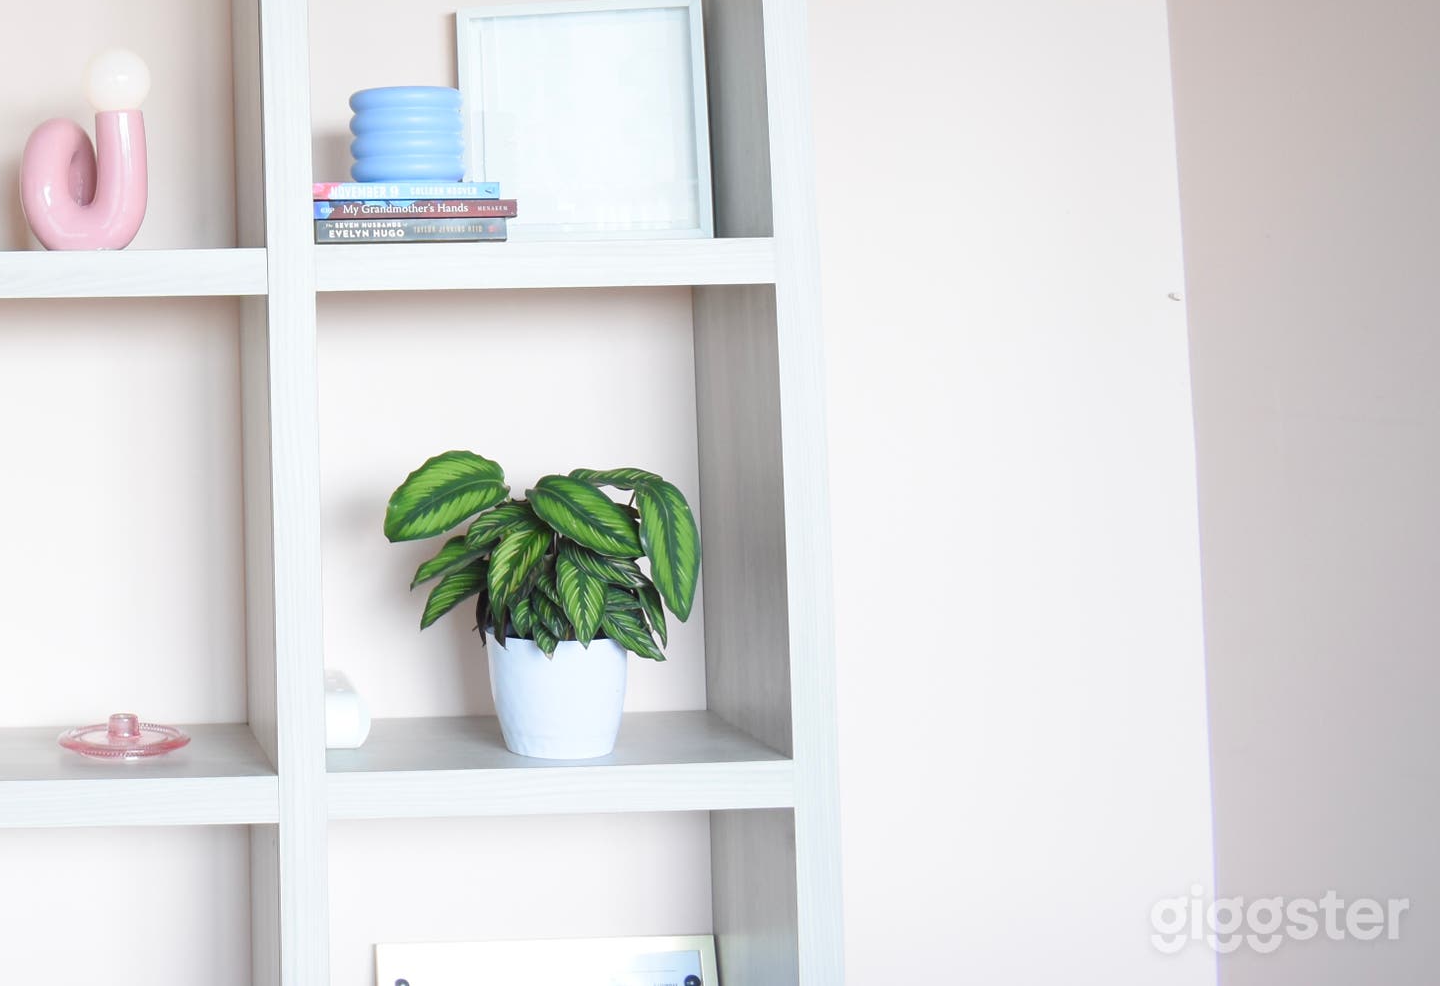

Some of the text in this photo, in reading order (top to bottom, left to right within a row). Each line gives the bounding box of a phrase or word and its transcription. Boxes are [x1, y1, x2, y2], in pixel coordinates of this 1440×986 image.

[329, 186, 400, 199] NOVEMBER 9
[343, 204, 358, 216] My
[361, 204, 435, 214] Grandmother's
[437, 203, 469, 213] Hands
[328, 229, 405, 238] EVELYN HUGO
